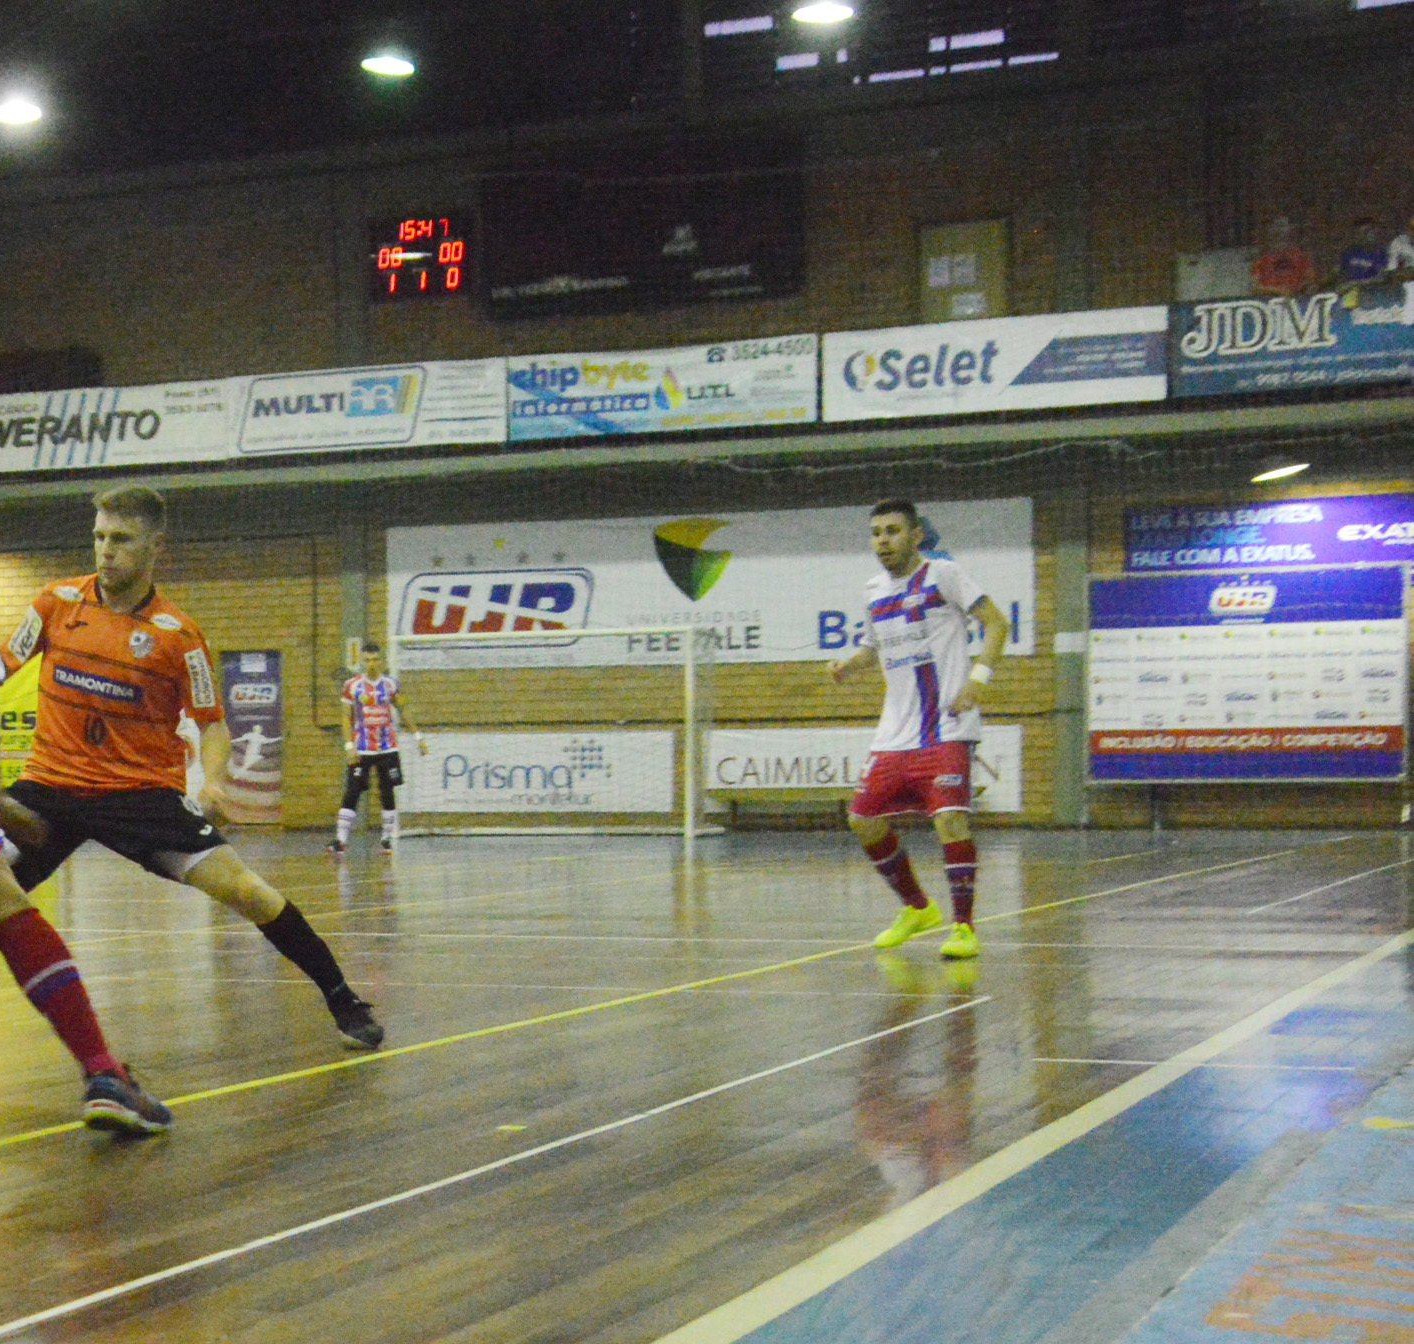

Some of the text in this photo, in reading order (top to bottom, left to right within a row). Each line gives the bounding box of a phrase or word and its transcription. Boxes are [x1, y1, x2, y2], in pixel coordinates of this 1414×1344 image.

[378, 241, 464, 270] 00 00
[389, 266, 461, 293] 1 1 0
[1181, 292, 1337, 358] JDM
[875, 340, 999, 391] Selet
[253, 392, 344, 418] MULTI
[1235, 504, 1324, 525] EMPRESA
[413, 583, 576, 635] UJR
[625, 609, 762, 626] UNIVERSIDADE
[628, 625, 762, 652] FEEALE
[55, 668, 134, 698] TRAMONTINA
[1185, 732, 1272, 749] EDUCAÇÃO
[1282, 731, 1387, 748] COMPETIÇÃO
[442, 753, 573, 789] Prisma
